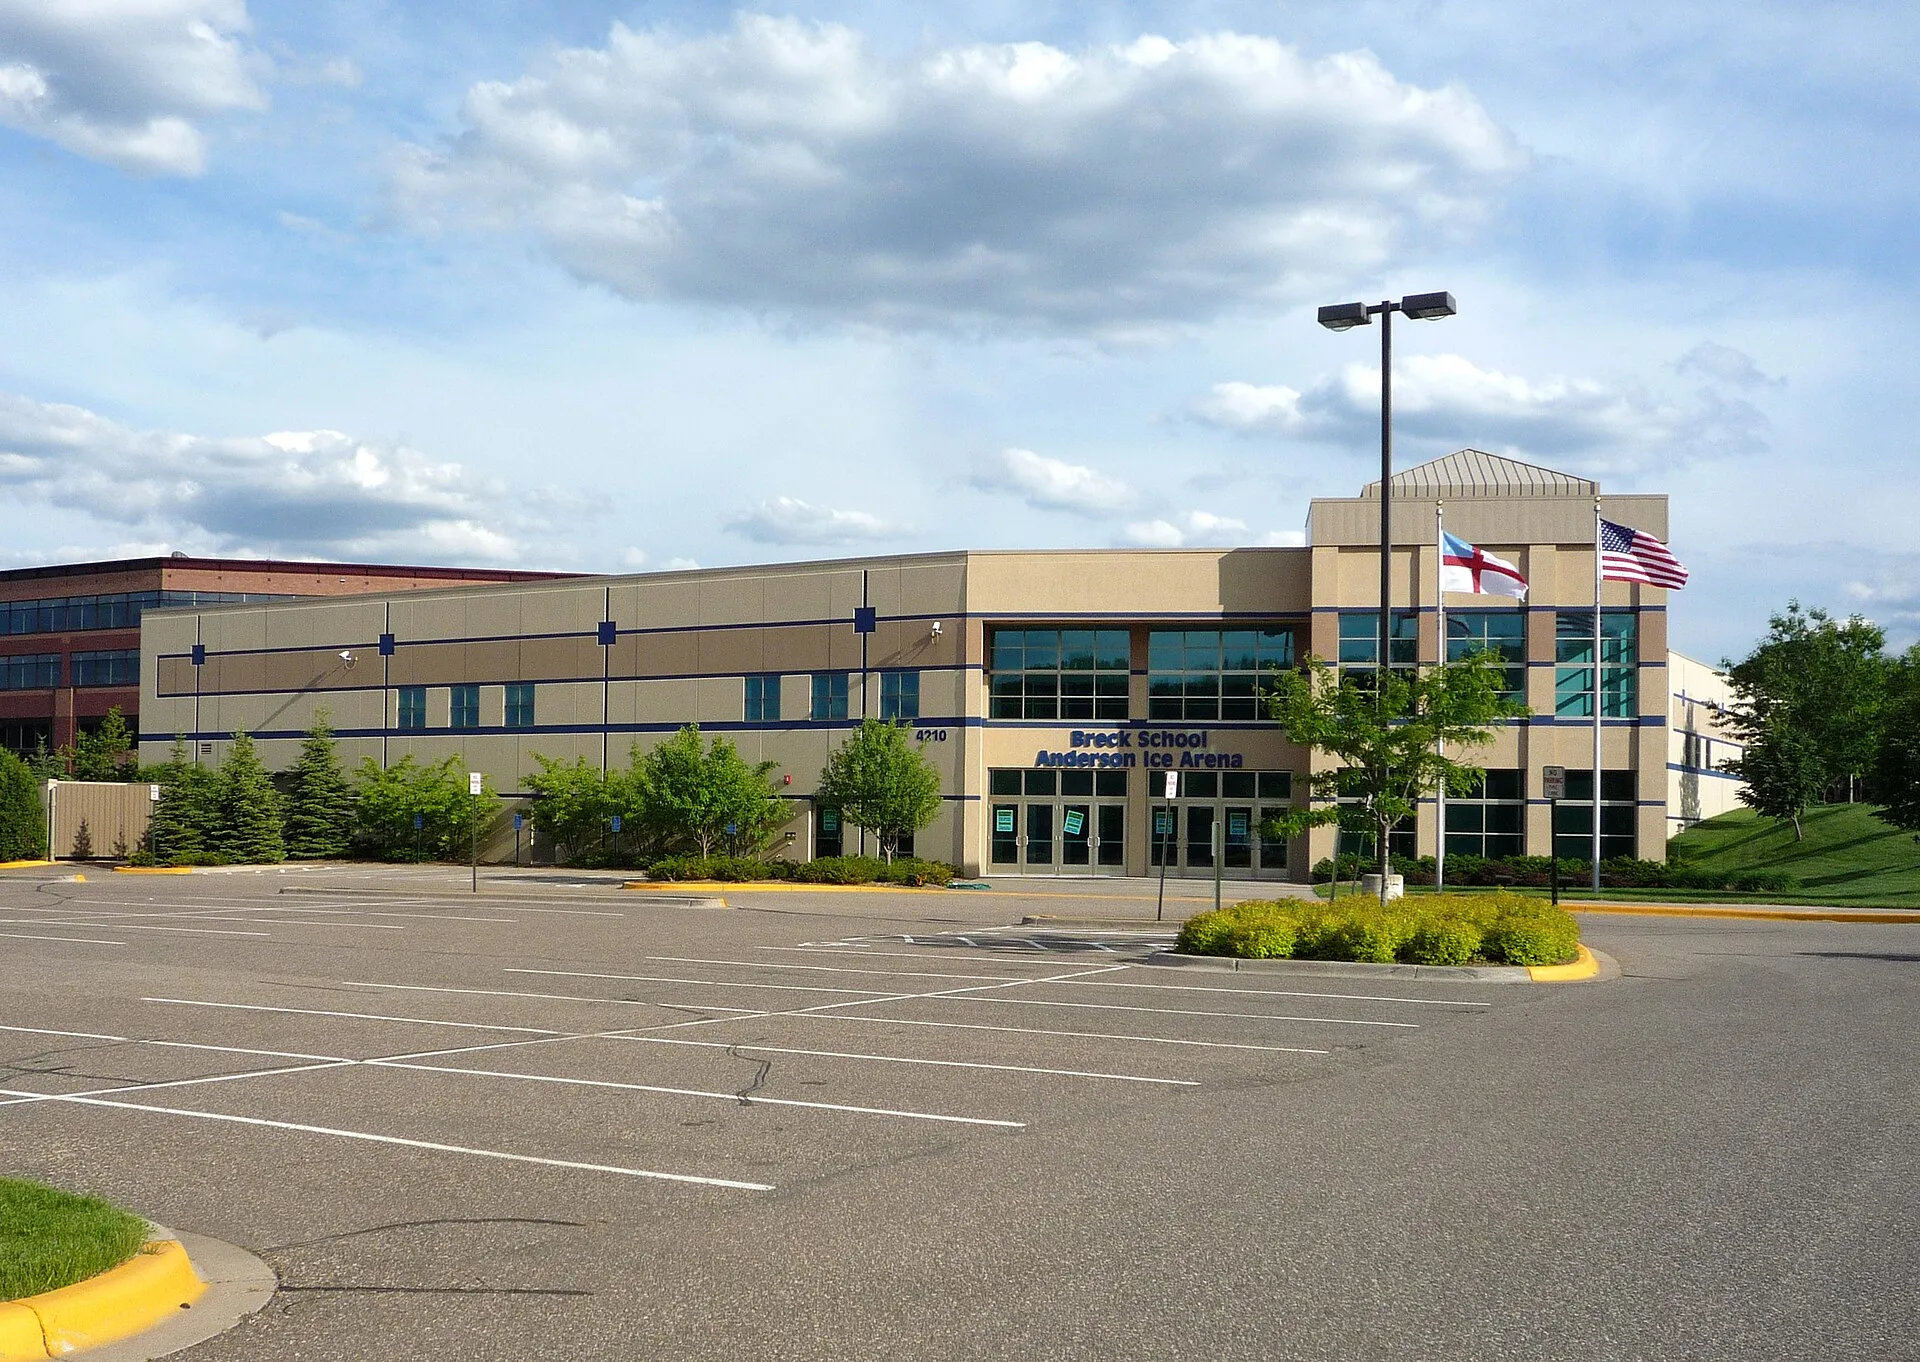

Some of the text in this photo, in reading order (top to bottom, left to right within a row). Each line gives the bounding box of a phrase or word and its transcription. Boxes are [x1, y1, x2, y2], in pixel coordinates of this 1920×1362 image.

[916, 730, 947, 741] 4210
[1070, 730, 1207, 748] Breck School
[1034, 750, 1243, 768] Anderson Ice Arena
